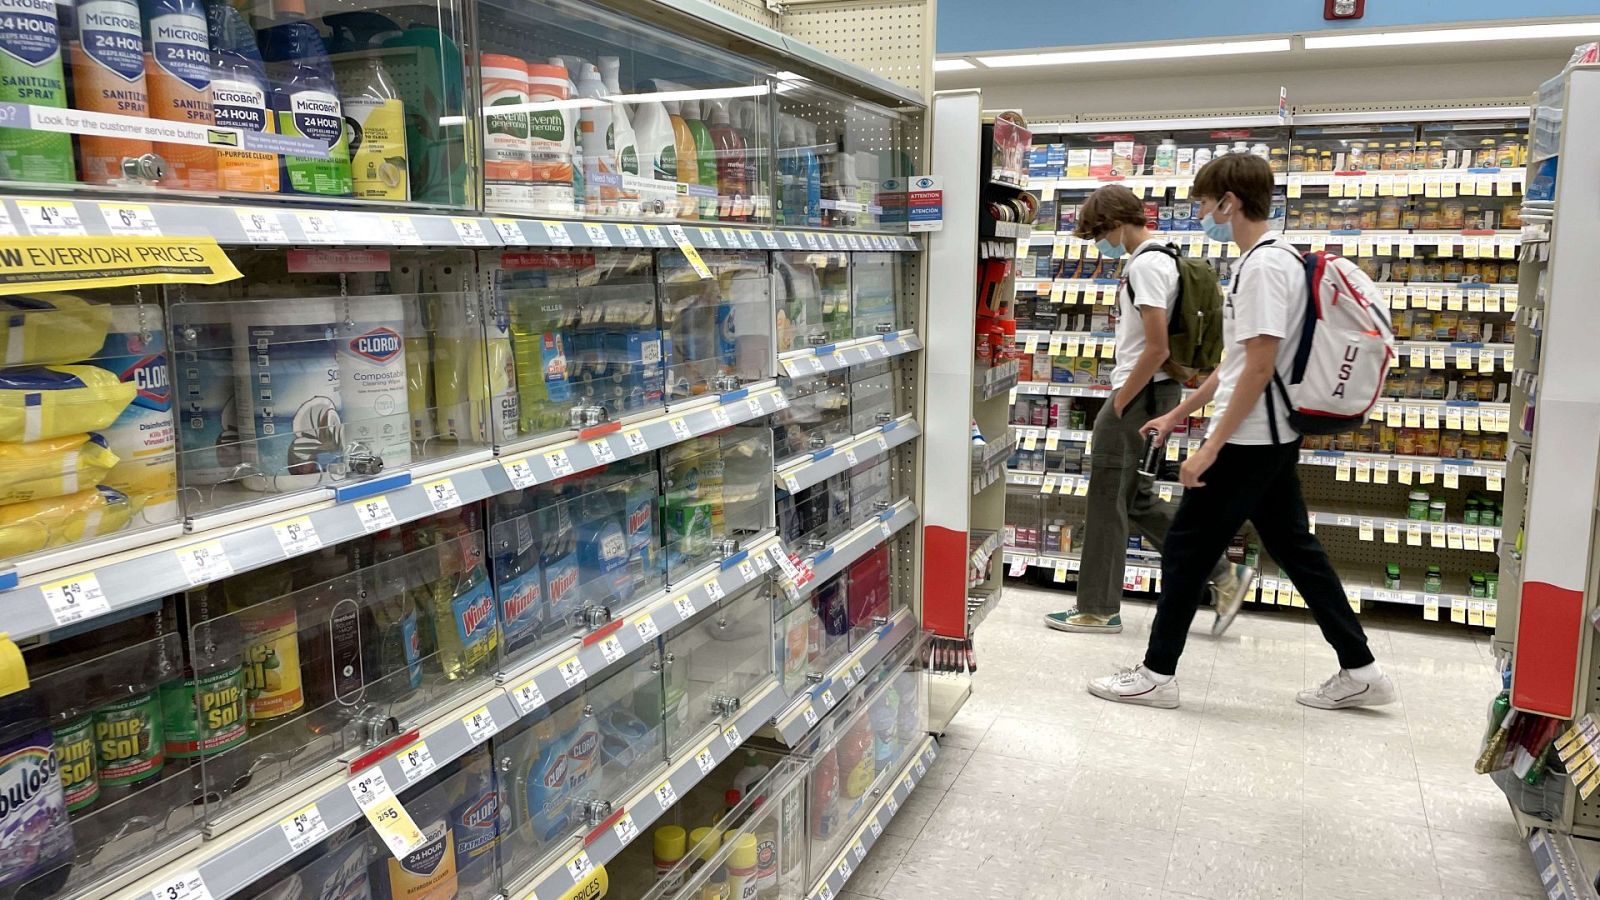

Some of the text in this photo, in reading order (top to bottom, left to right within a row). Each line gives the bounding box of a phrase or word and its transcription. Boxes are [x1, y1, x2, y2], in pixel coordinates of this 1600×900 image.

[17, 18, 56, 34] HOUR
[86, 13, 140, 31] MICROBA
[96, 35, 115, 47] 24
[167, 48, 210, 63] 24 HOU
[18, 88, 54, 99] SPRAY
[118, 101, 145, 112] SPRAY
[297, 101, 338, 113] MICROBAN
[187, 110, 212, 121] SPRAY
[215, 109, 259, 121] 24 HOUR
[37, 113, 204, 141] Look for the customer service button
[304, 117, 338, 129] 24 HOUR
[491, 119, 527, 131] generation
[911, 207, 939, 215] ATENCIÓN
[28, 247, 136, 266] EVERYDAY
[136, 247, 205, 263] PRICES
[102, 270, 122, 278] sprays
[359, 337, 399, 353] CLOROX
[134, 365, 170, 390] CLOR
[1332, 345, 1359, 400] USA
[362, 380, 387, 388] Cleaning
[333, 613, 356, 623] method
[208, 702, 238, 730] Sol
[102, 735, 140, 761] Sol
[60, 756, 91, 787] Sol
[359, 777, 373, 794] 349
[410, 854, 421, 863] 24
[421, 842, 442, 858] HOUR
[407, 880, 433, 895] BATHROOM
[574, 876, 600, 900] PRICES
